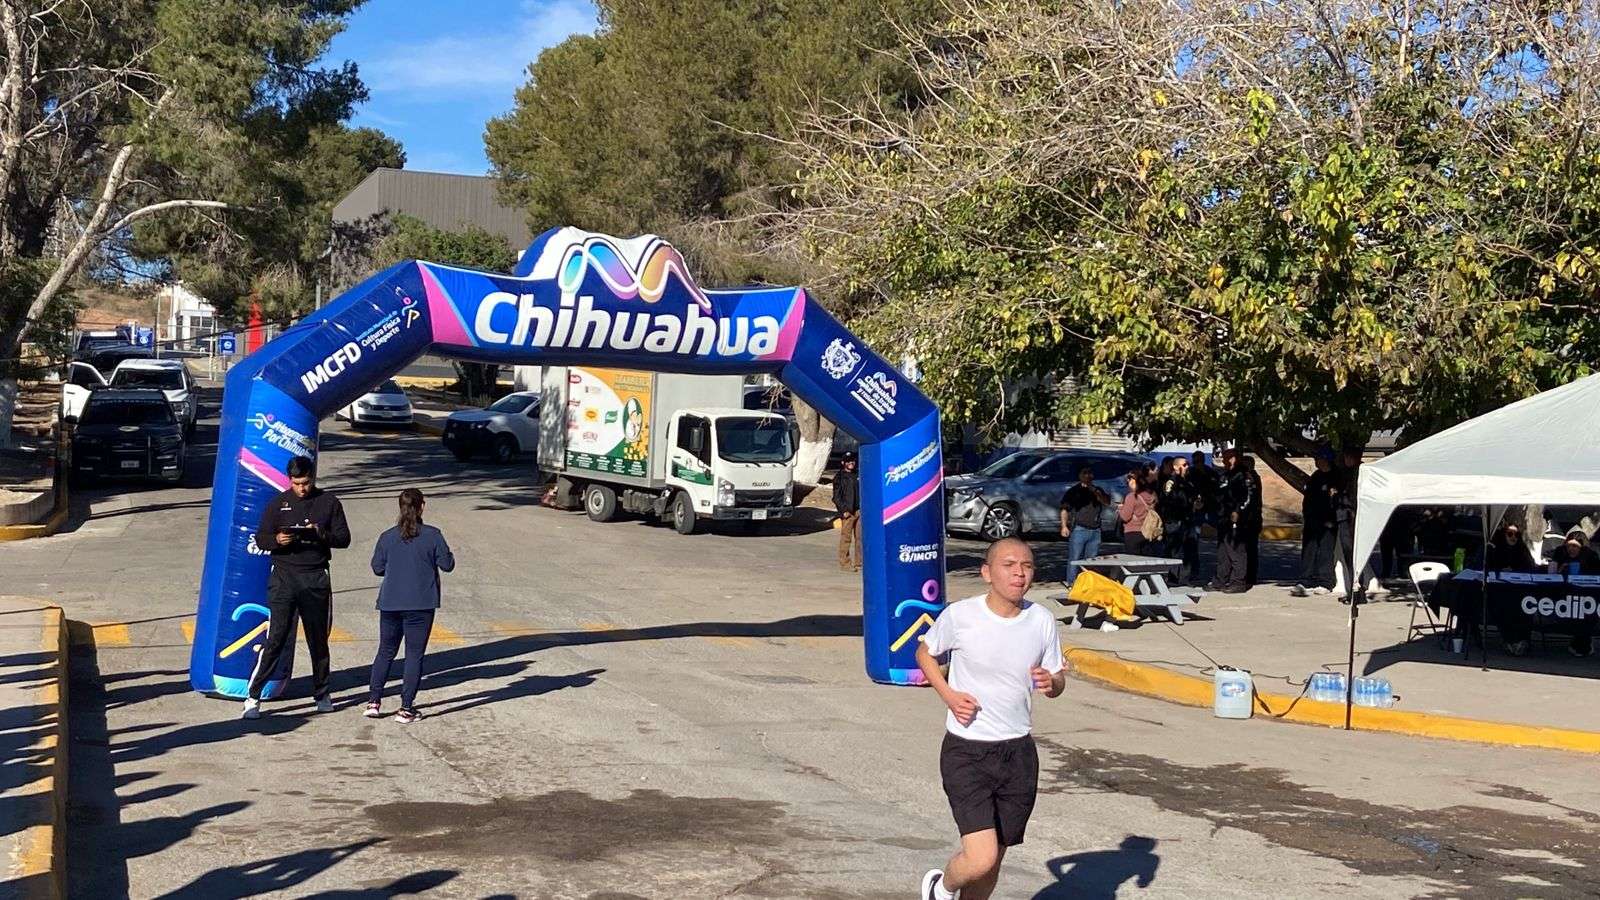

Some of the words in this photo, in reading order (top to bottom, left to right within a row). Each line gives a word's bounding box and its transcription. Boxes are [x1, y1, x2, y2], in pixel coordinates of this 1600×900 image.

[360, 328, 384, 346] Cultura
[475, 291, 779, 356] Chihuahua
[370, 343, 377, 351] y
[375, 326, 400, 346] Deporte
[301, 342, 361, 394] IMCFD
[865, 376, 896, 406] Chihuahua
[1521, 595, 1600, 619] cedip
